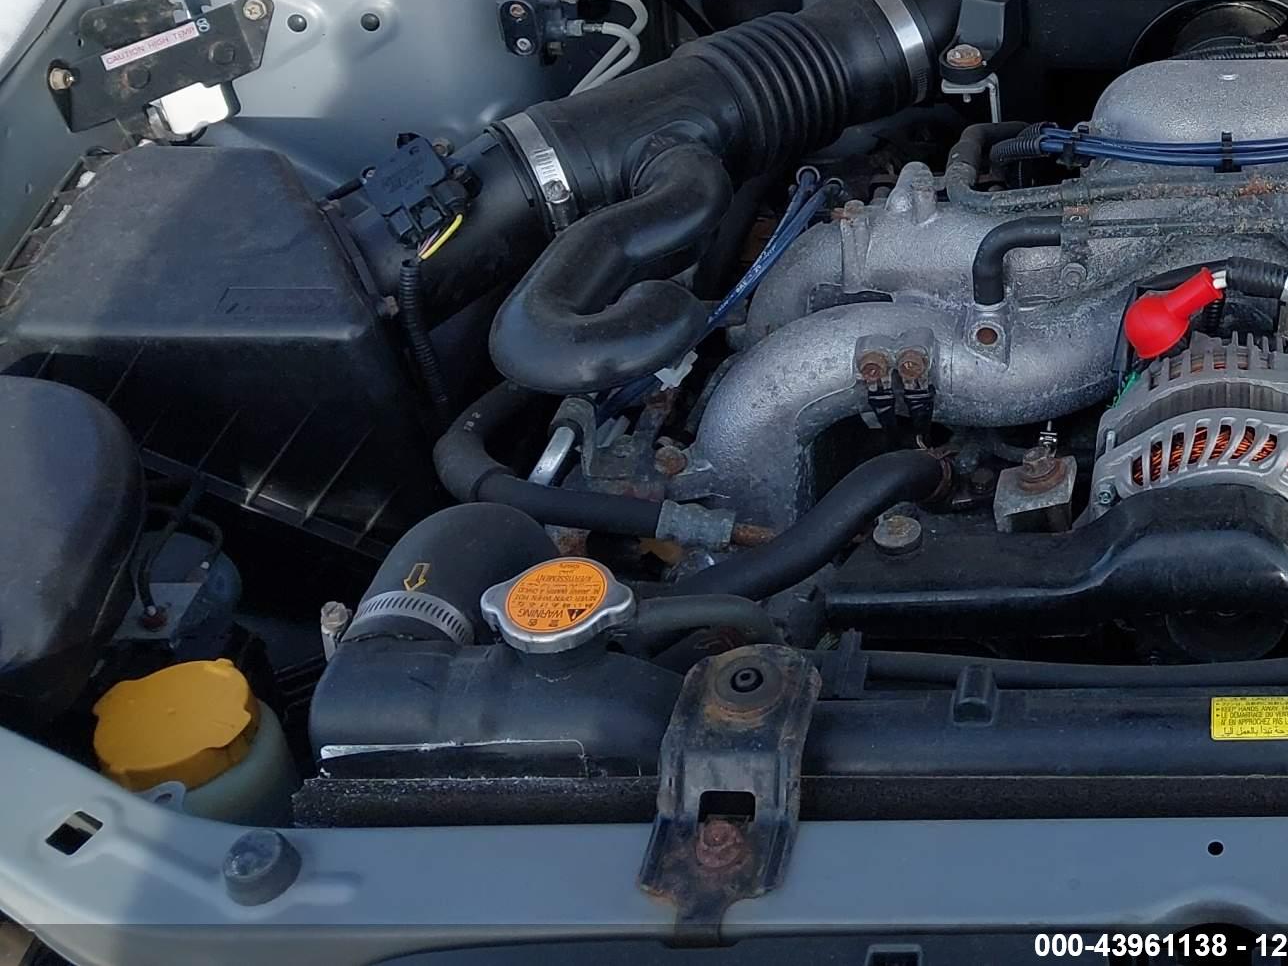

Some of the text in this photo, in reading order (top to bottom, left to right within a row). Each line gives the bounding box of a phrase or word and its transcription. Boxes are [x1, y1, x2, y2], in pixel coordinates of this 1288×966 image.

[106, 45, 146, 66] CAUTION
[147, 37, 170, 52] HIGH
[517, 608, 564, 618] WARNING
